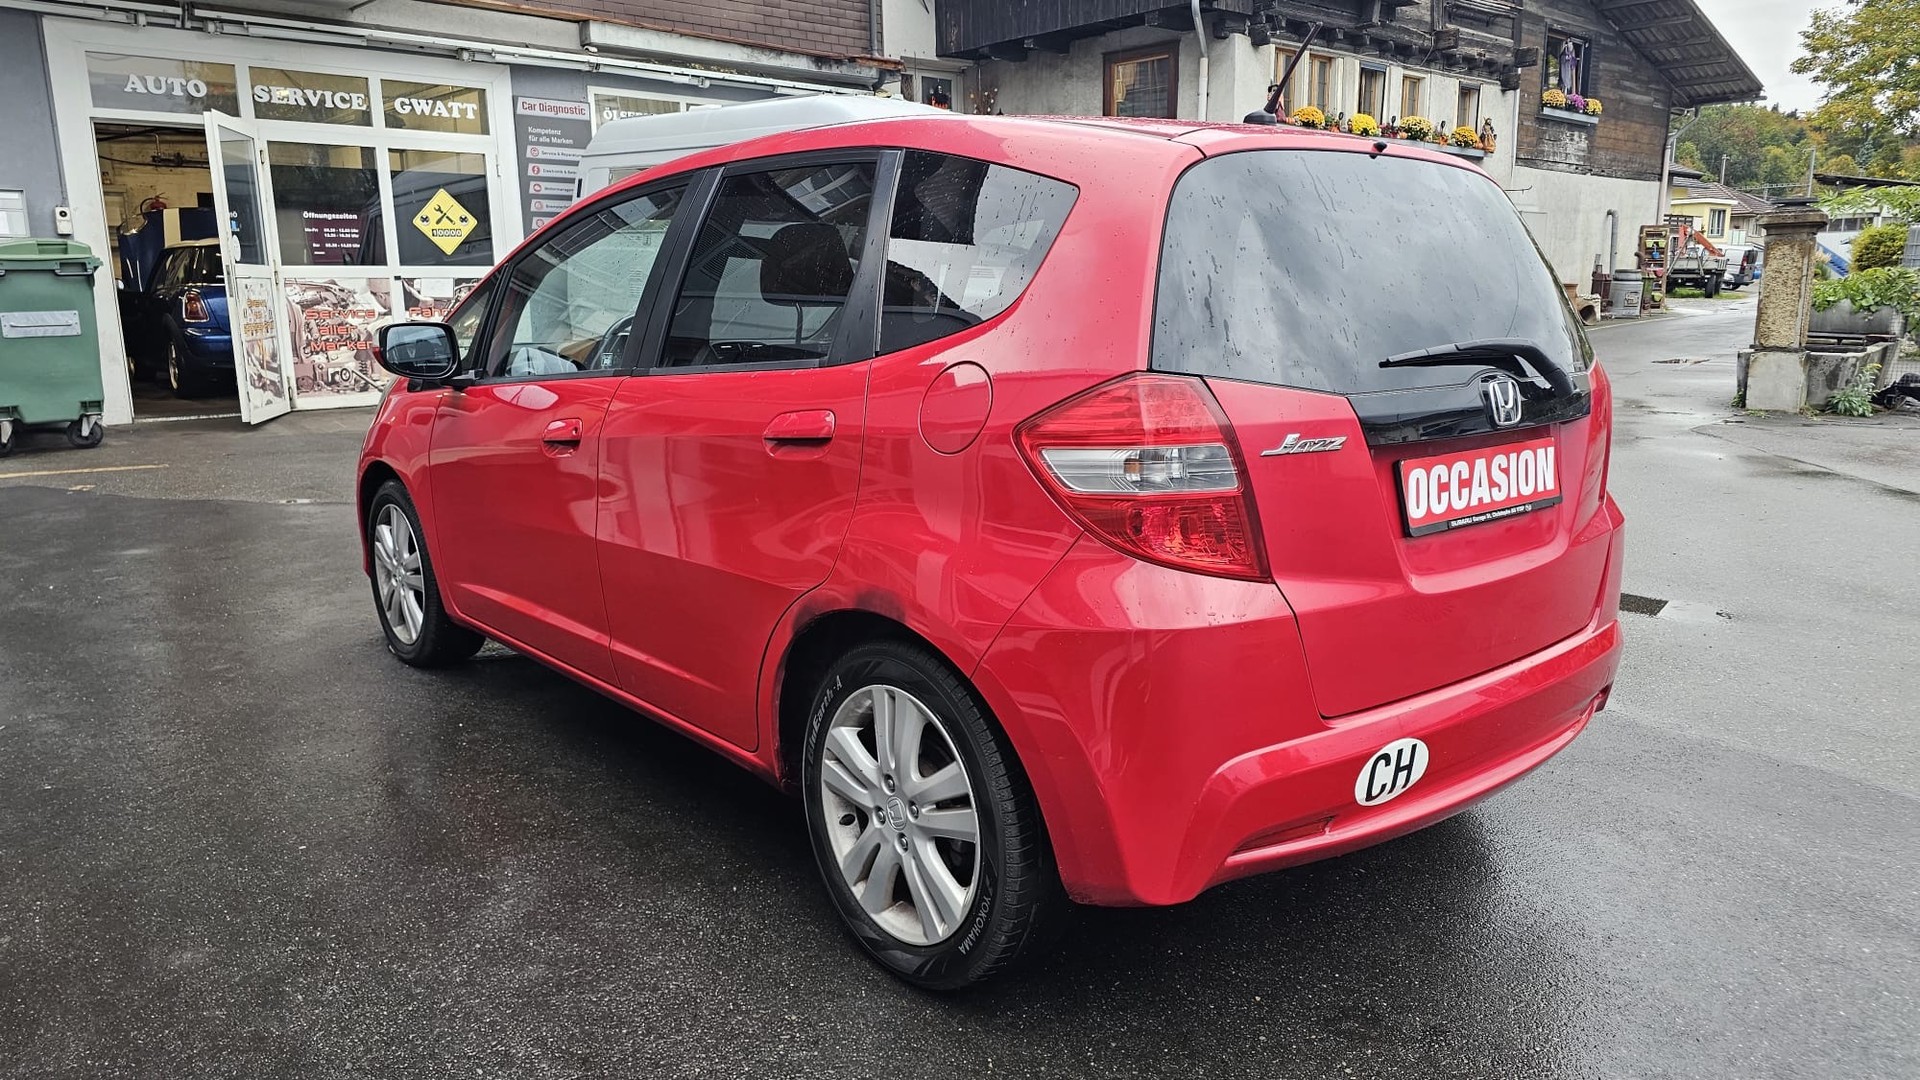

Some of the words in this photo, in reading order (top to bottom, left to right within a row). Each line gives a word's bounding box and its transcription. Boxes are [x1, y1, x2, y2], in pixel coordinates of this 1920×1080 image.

[124, 73, 207, 98] AUTO
[252, 84, 368, 110] SERVICE
[393, 97, 478, 120] GWATT
[521, 101, 537, 111] Car
[539, 102, 586, 115] Diagnostic
[528, 126, 561, 136] Kompetenz
[551, 136, 574, 144] Marken
[303, 211, 358, 220] Öffnungszeiten
[432, 229, 462, 237] 10000
[305, 309, 376, 320] Service
[408, 306, 451, 317] Fahr
[319, 325, 358, 335] aller
[1260, 433, 1348, 457] Jazz
[1408, 446, 1555, 520] OCCASION
[1365, 743, 1417, 802] CH
[958, 895, 991, 955] YOKOHAMA
